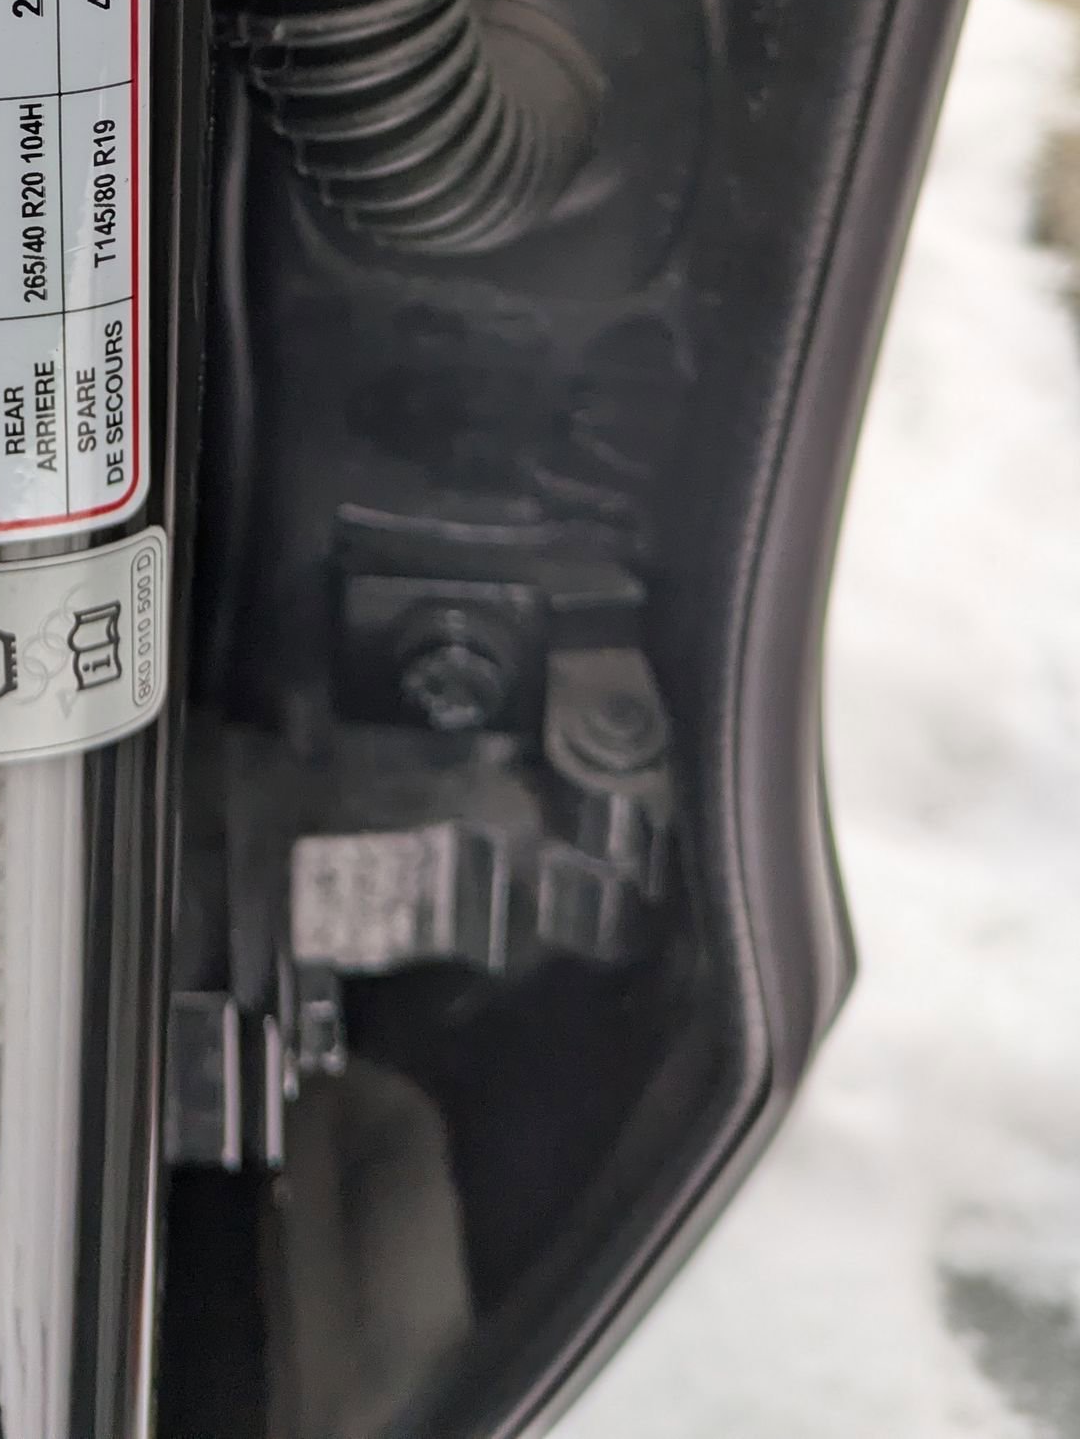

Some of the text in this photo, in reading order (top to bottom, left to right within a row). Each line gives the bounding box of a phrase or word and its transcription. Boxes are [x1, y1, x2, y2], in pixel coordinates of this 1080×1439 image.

[20, 104, 47, 302] 265/40 R20 104H
[93, 120, 116, 268] T145/80 R19
[4, 386, 25, 455] REAR
[34, 361, 56, 471] ARRIERE
[77, 367, 97, 452] SPARE
[105, 320, 124, 485] DE SECOURS
[137, 554, 151, 700] 8K0 010 500 D
